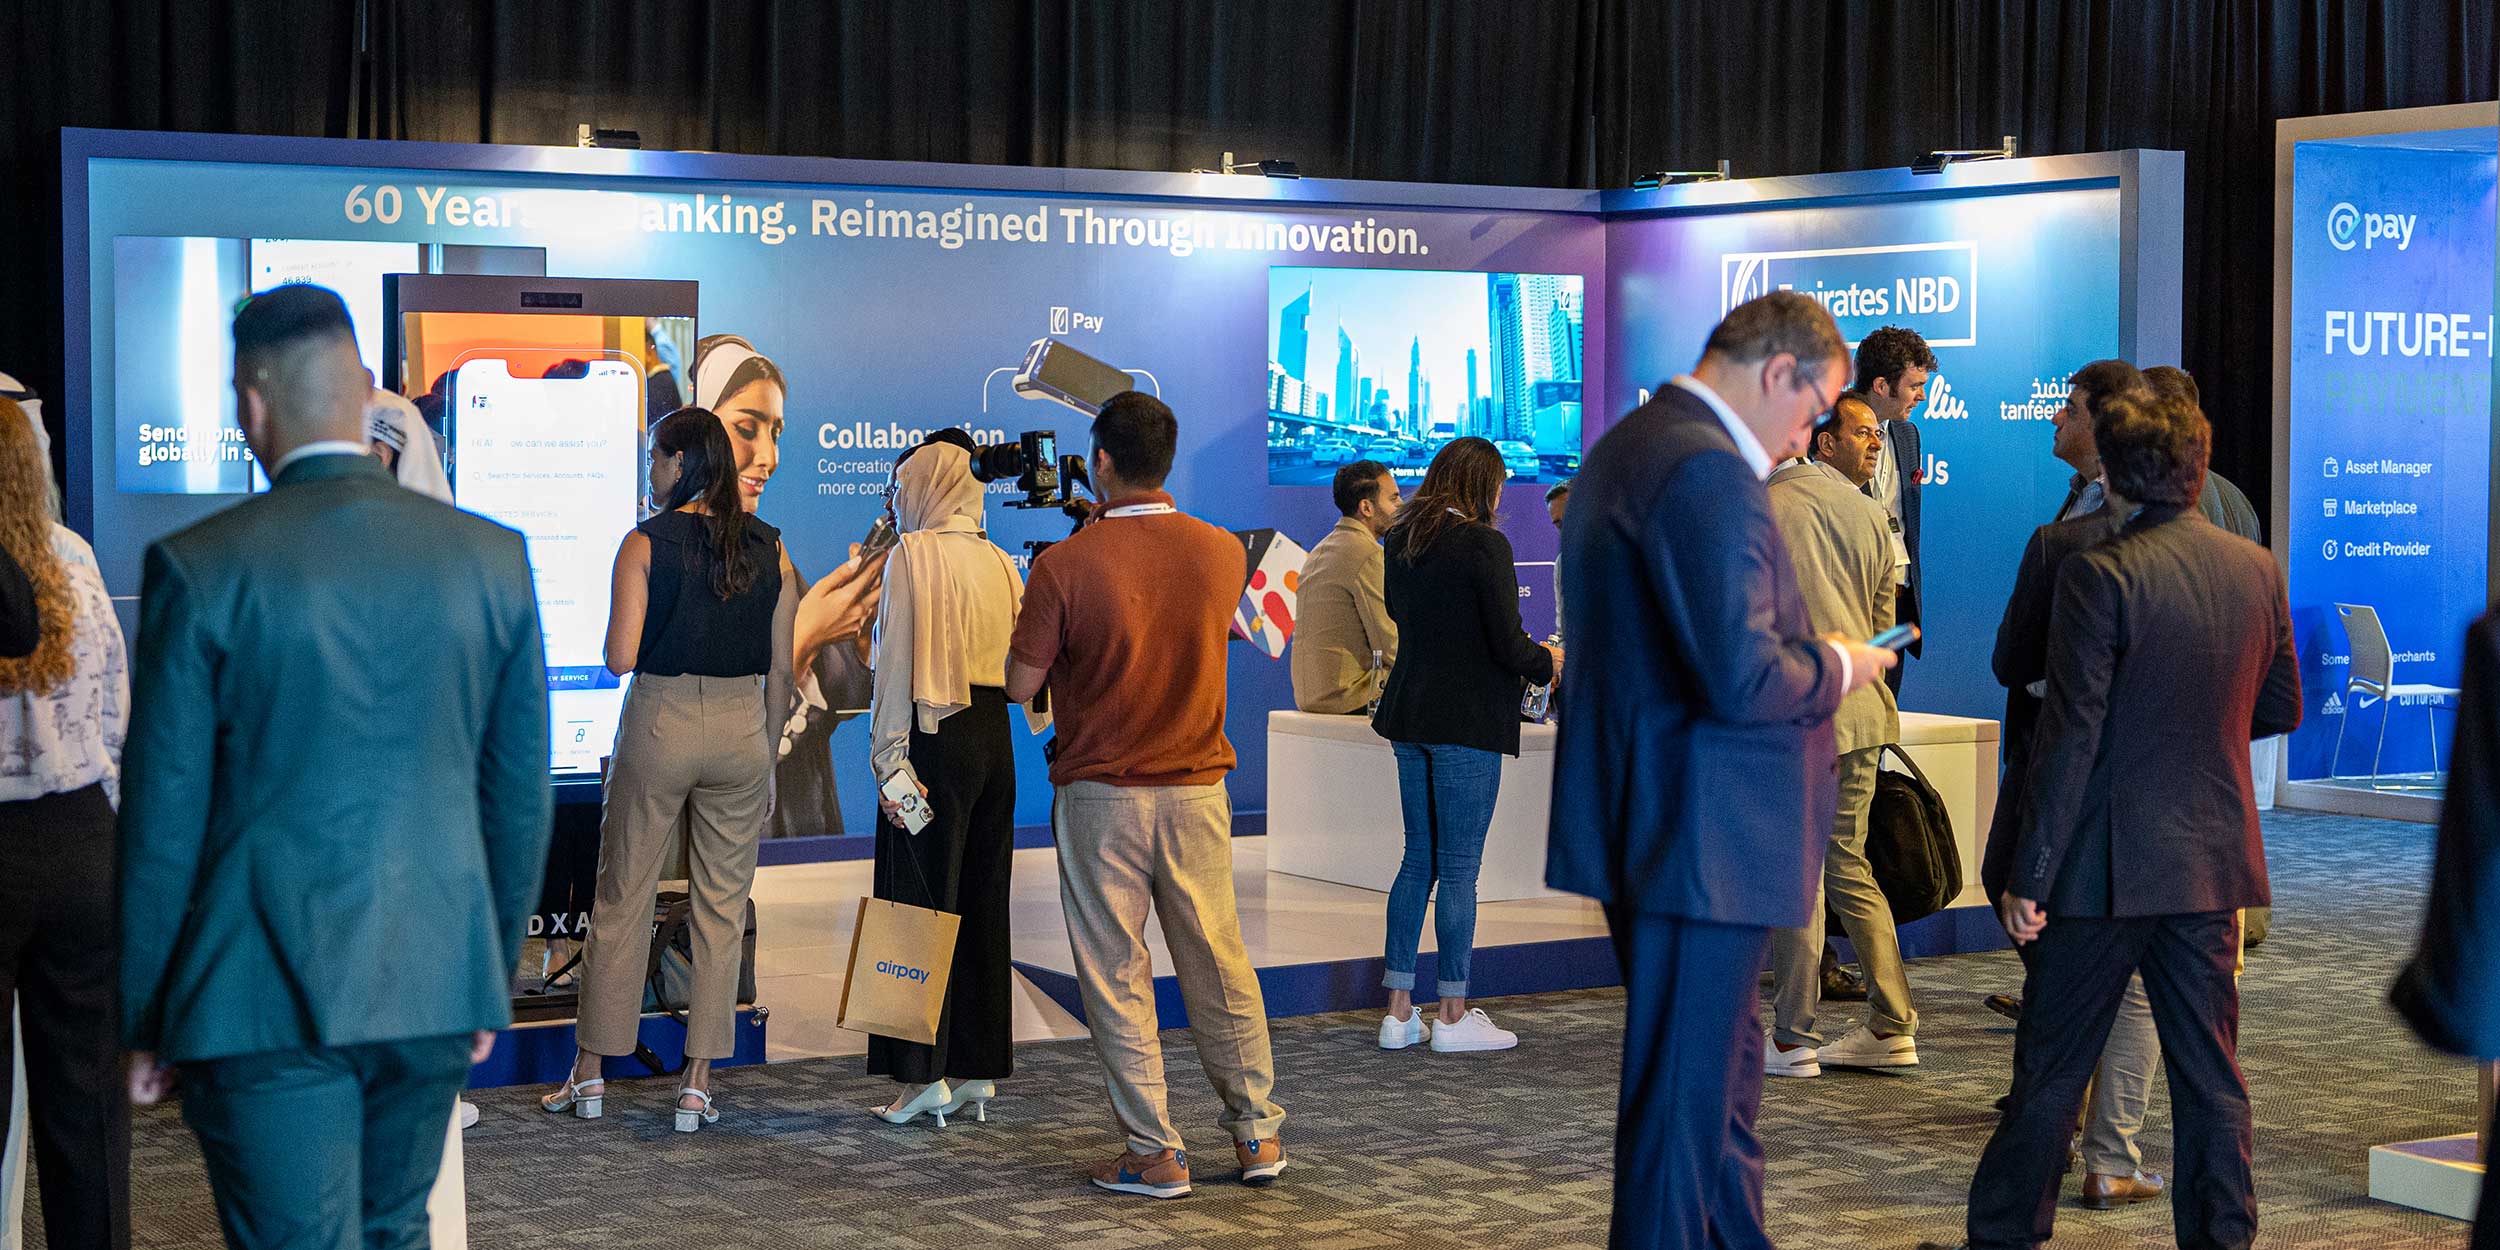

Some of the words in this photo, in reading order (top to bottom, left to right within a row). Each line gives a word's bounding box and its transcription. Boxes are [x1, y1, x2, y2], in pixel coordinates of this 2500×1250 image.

[344, 184, 402, 225] 60
[416, 187, 536, 231] Year
[638, 194, 798, 245] anking.
[811, 199, 1048, 249] Reimagined
[1060, 208, 1216, 257] Through
[1778, 280, 1889, 317] irates
[1896, 276, 1961, 315] NBD
[1073, 312, 1104, 333] Pay
[2325, 310, 2494, 358] FUTURE-
[1924, 375, 1969, 420] liv.
[139, 423, 190, 442] Send
[818, 422, 1005, 449] Collaboion
[221, 442, 239, 461] in
[558, 439, 584, 448] assist
[817, 457, 894, 475] Co-creatio
[2345, 459, 2379, 475] Asset
[2381, 459, 2433, 478] Manager
[818, 481, 856, 496] more
[860, 481, 888, 496] con
[2344, 500, 2418, 518] Marketplace
[2344, 541, 2382, 558] Credit
[2383, 541, 2432, 557] Provider
[2321, 653, 2350, 665] Some
[2392, 650, 2436, 663] erchants
[560, 674, 589, 682] SERVICE
[875, 959, 930, 985] airpay
